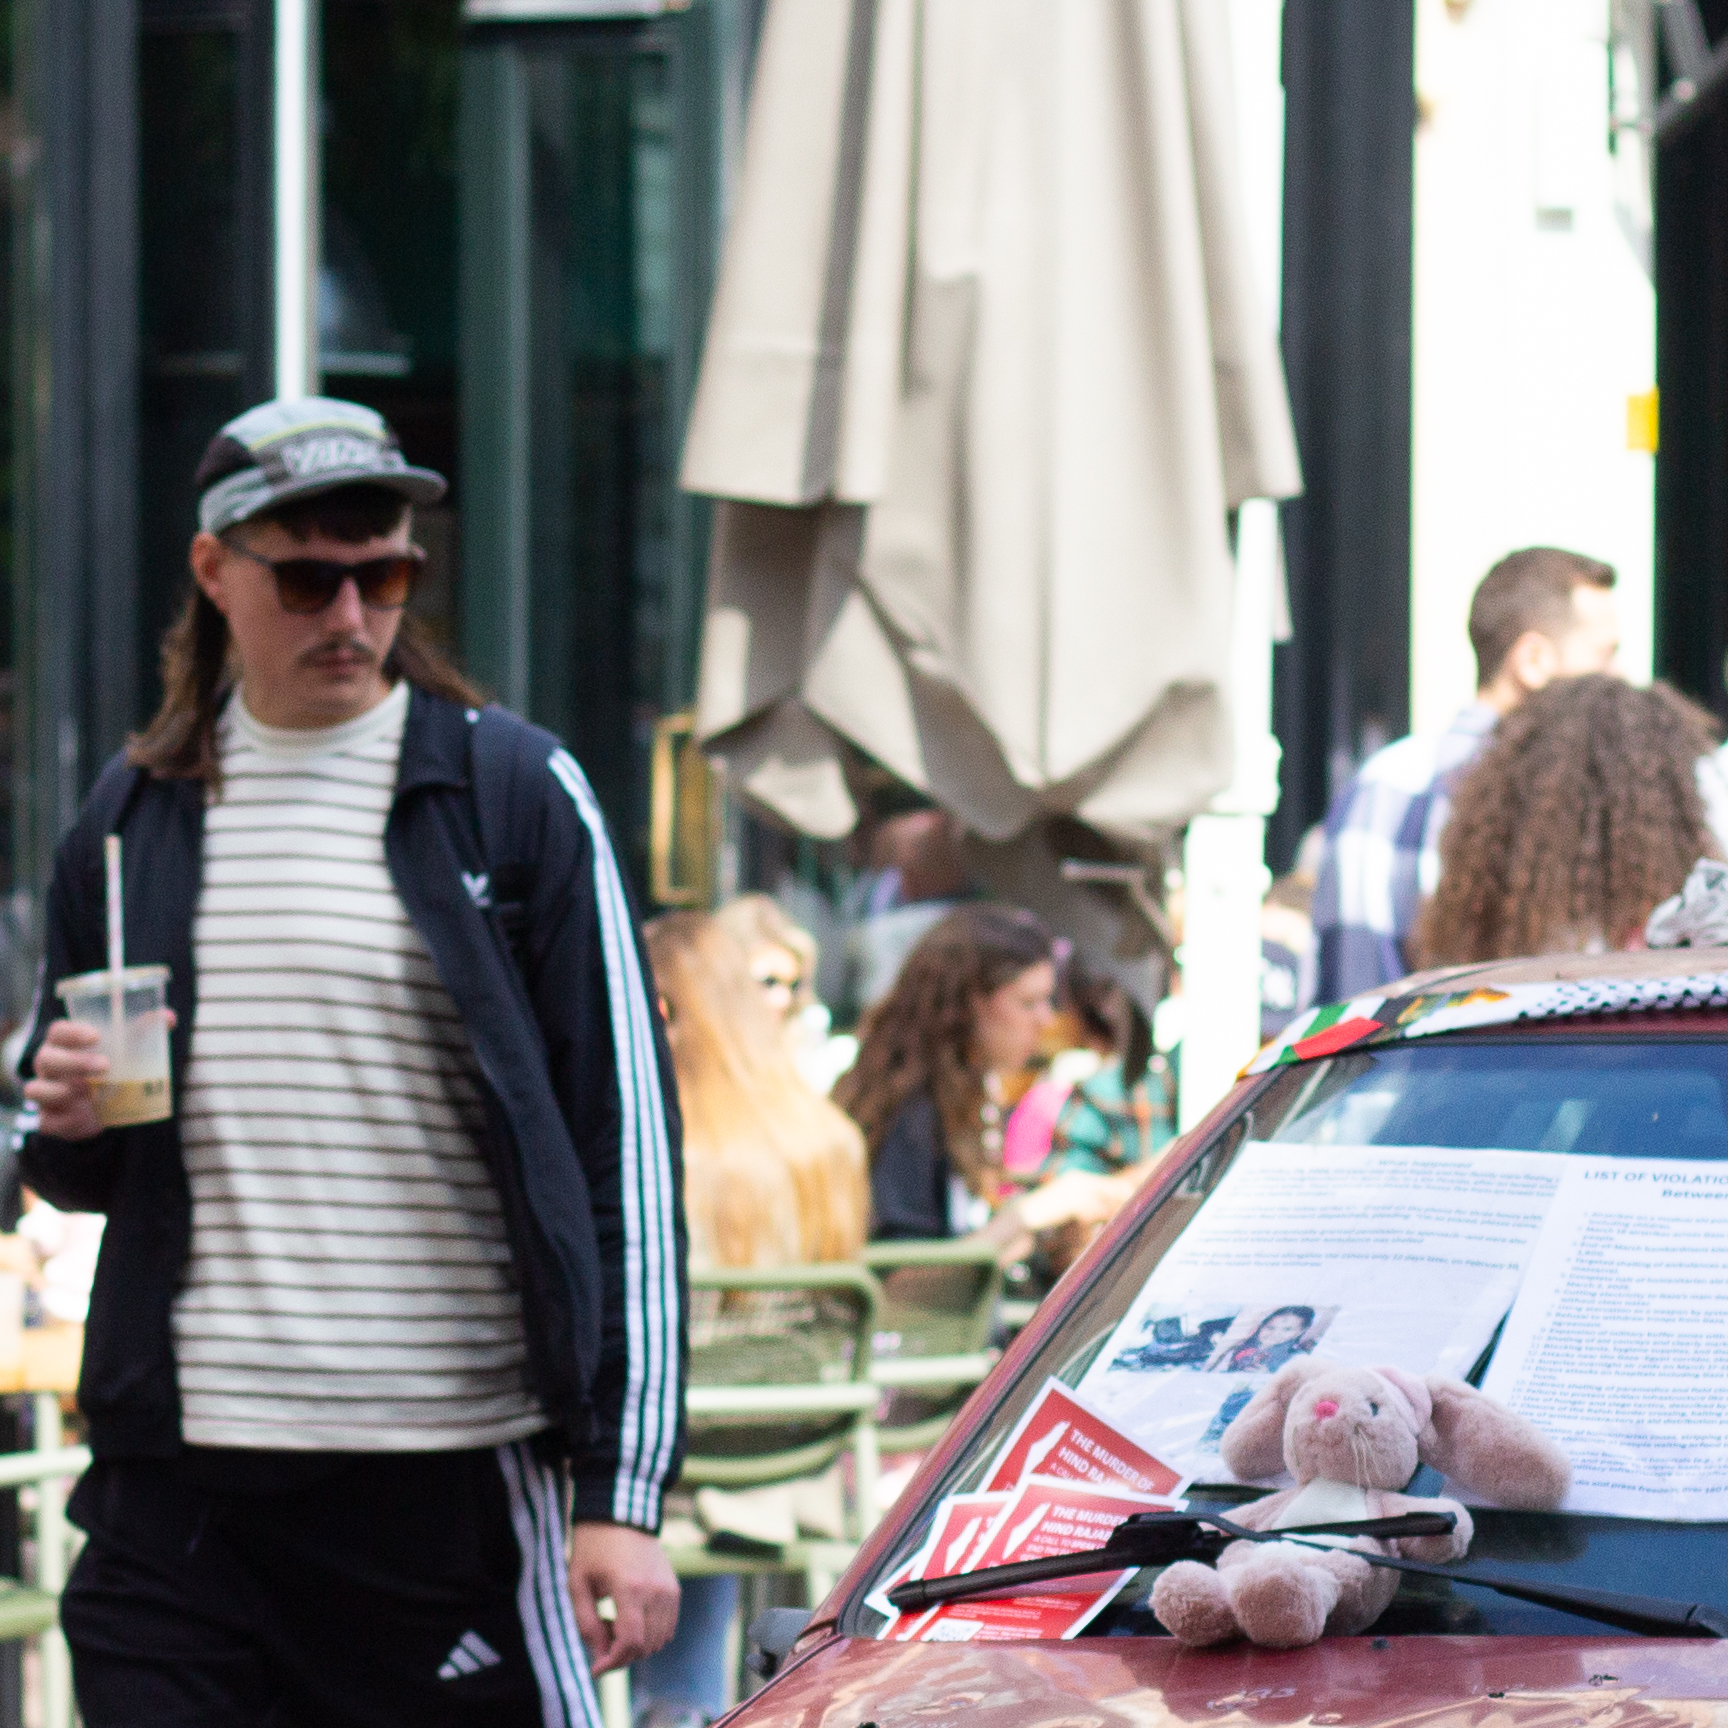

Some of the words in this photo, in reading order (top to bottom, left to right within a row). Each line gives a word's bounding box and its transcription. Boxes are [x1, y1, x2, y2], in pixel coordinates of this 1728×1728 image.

[1412, 1160, 1473, 1169] happened
[1584, 1170, 1620, 1181] LIST
[1624, 1172, 1648, 1182] OF
[1058, 1446, 1088, 1472] HIND
[1070, 1428, 1094, 1452] THE
[1092, 1445, 1139, 1483] MURDER
[1137, 1477, 1156, 1491] OF
[1052, 1505, 1076, 1518] THE
[1041, 1521, 1073, 1535] HIND
[1040, 1536, 1059, 1545] CALL
